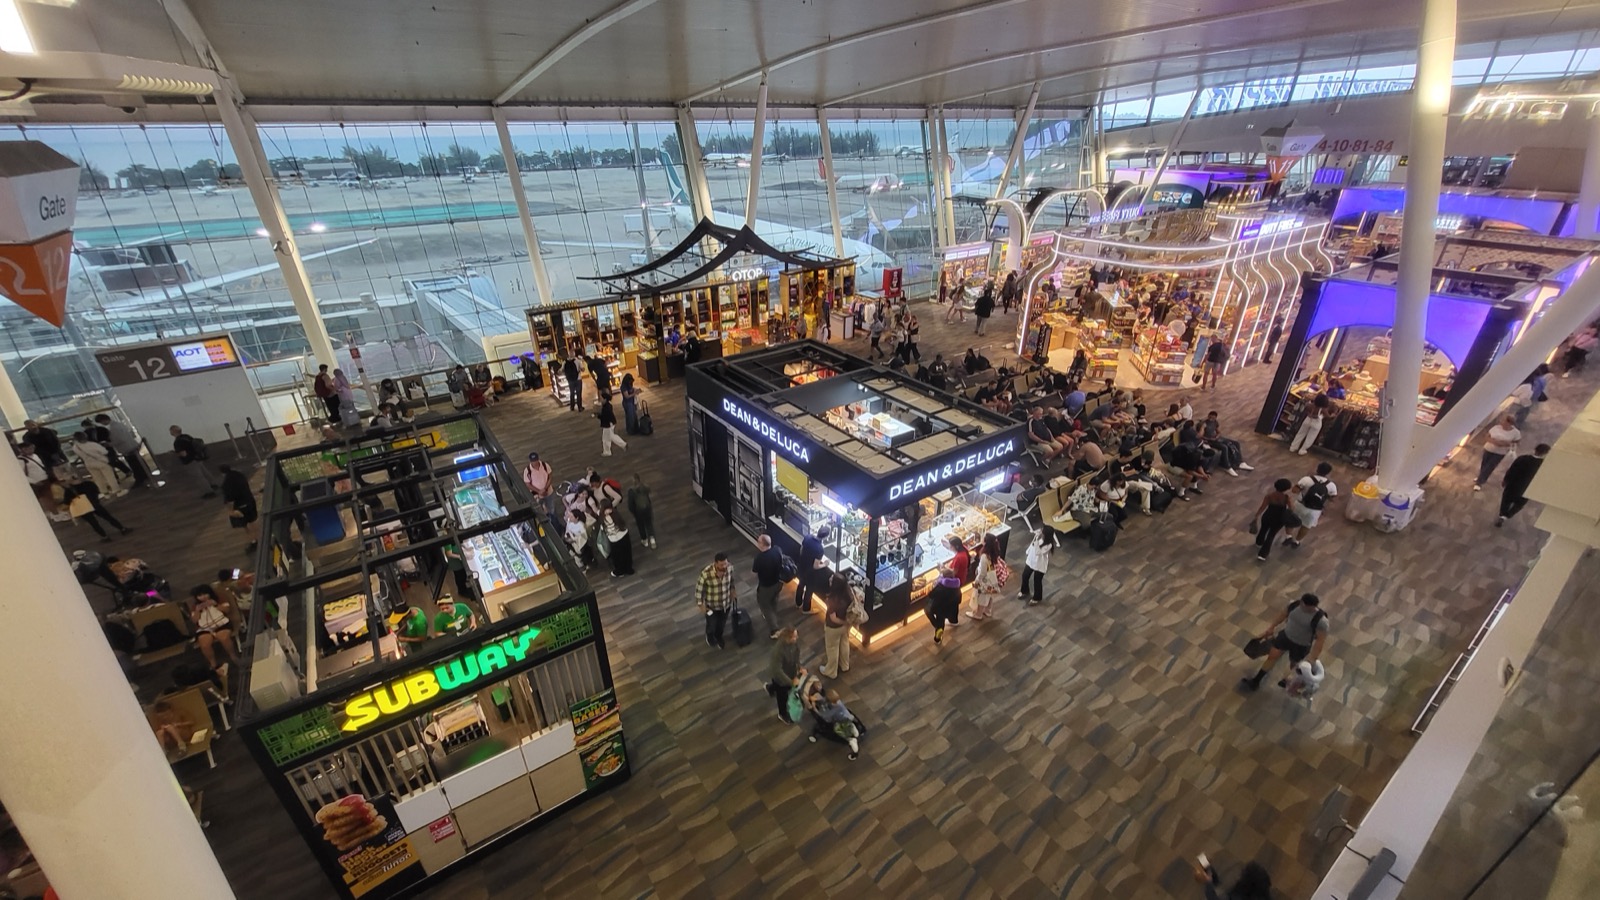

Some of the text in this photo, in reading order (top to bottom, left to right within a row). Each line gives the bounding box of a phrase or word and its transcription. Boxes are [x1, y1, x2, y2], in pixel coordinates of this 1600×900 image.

[1269, 159, 1277, 174] 11
[1278, 159, 1295, 175] 11
[39, 195, 67, 221] Gate
[1259, 221, 1279, 236] DUTY
[1277, 218, 1296, 231] FREE
[44, 246, 68, 295] 12
[732, 267, 763, 281] OTOP
[101, 354, 126, 364] Gate
[175, 347, 202, 357] AOT
[128, 357, 171, 380] 12
[723, 398, 810, 463] DEAN & DELUCA
[889, 440, 1014, 501] DEAN & DELUCA
[342, 627, 542, 731] SUBWAY
[572, 701, 603, 719] PLANT
[573, 704, 609, 724] BASED
[344, 842, 388, 871] pepper
